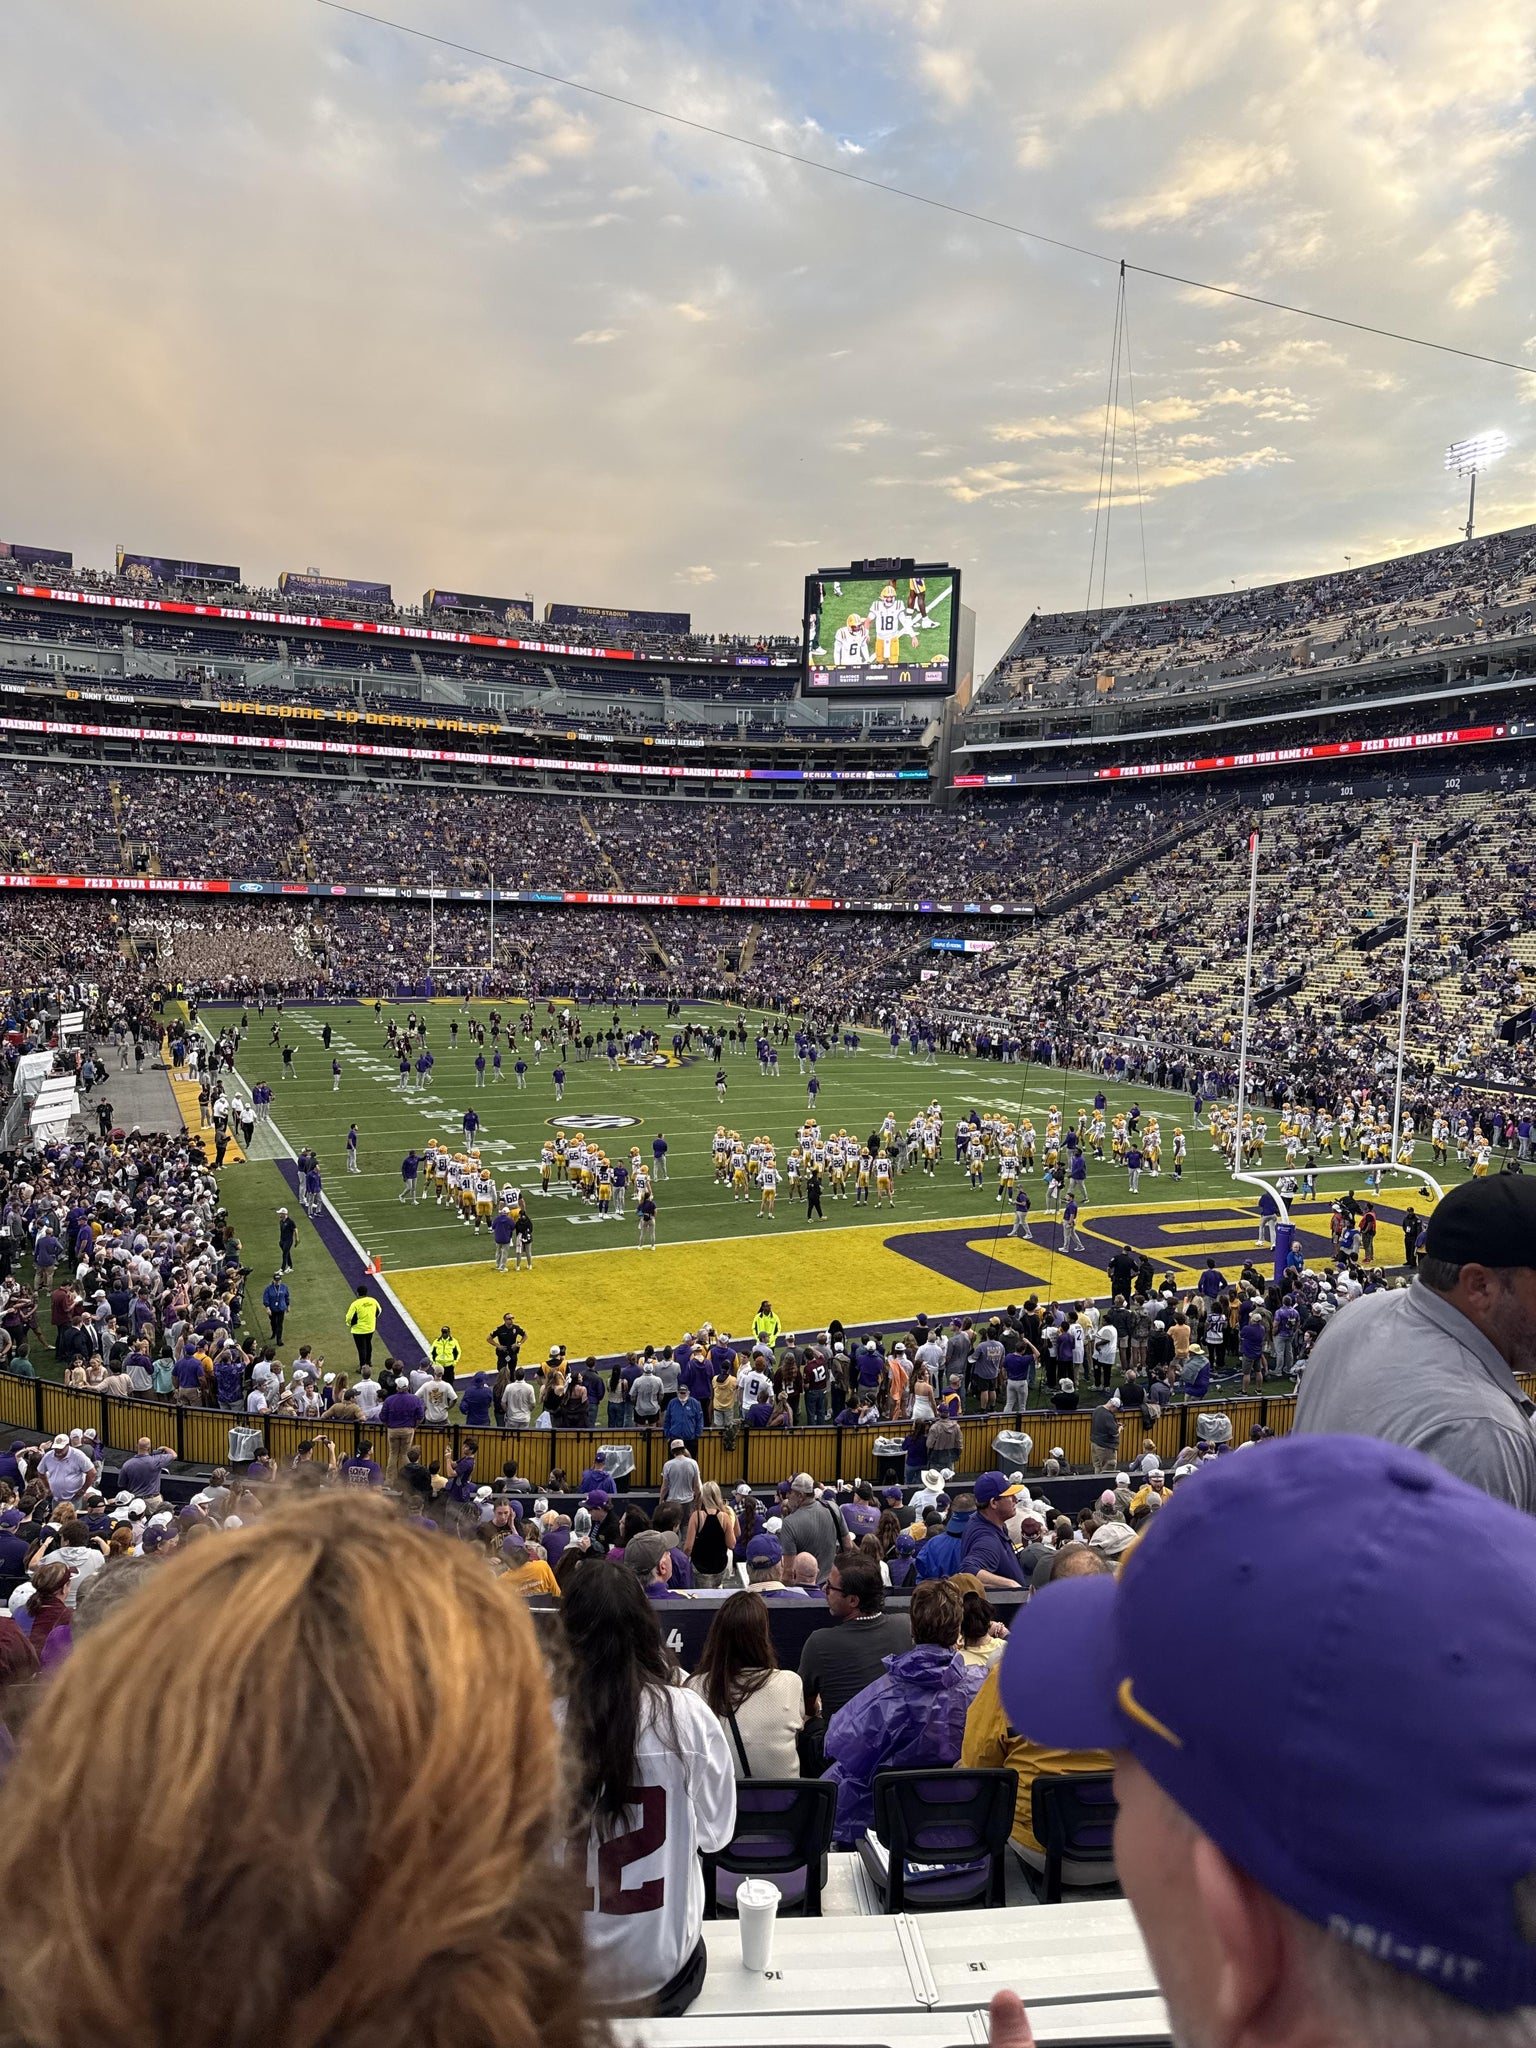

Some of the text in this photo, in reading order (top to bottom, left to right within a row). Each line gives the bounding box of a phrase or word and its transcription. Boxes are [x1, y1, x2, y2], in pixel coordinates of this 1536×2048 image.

[863, 558, 900, 572] LSU
[296, 576, 348, 587] TIGER STADIUM
[51, 591, 78, 602] FEED
[83, 594, 111, 606] YOUR
[115, 598, 144, 609] GAME
[220, 608, 246, 618] FEED
[250, 612, 276, 622] YOUR
[279, 615, 307, 626] GAME
[602, 610, 628, 618] STADIUM
[881, 616, 894, 630] 18
[376, 624, 400, 635] FEED
[404, 628, 428, 638] YOUR
[431, 631, 456, 642] GAME
[518, 641, 540, 650] FEED
[544, 644, 566, 654] YOUR
[568, 647, 592, 656] GAME
[850, 644, 858, 655] 6
[1, 685, 25, 693] CANNON
[81, 692, 101, 700] TOMMY
[220, 701, 500, 734] WELCOME TO DEATH VALLEY
[0, 719, 82, 732] RAISING CANE'S
[1511, 726, 1518, 734] 0
[100, 727, 178, 740] RAISING CANE'S
[195, 734, 270, 746] RAISING CANE'S
[655, 738, 676, 746] CHARLES
[1361, 740, 1384, 750] FEED
[1388, 737, 1412, 748] YOUR
[1416, 734, 1442, 745] GAME
[286, 740, 356, 752] RAISING CANE'S
[372, 746, 440, 759] RAISING CANE'S
[1234, 754, 1253, 765] FEED
[1256, 752, 1276, 762] YOUR
[1278, 748, 1301, 760] GAME
[455, 752, 520, 765] RAISING CANE'S
[534, 758, 594, 770] RAISING CANE'S
[608, 764, 670, 775] RAISING CANE'S
[684, 768, 745, 778] RAISING CANE'S
[1120, 767, 1138, 776] FEED
[1142, 764, 1160, 774] YOUR
[1163, 763, 1185, 772] GAME
[1445, 779, 1460, 789] 102
[1341, 787, 1354, 796] 101
[1262, 793, 1274, 802] 100
[84, 879, 112, 888] FEED
[117, 880, 146, 890] YOUR
[150, 880, 180, 890] GAME
[401, 889, 411, 897] 40
[587, 894, 608, 902] FEED
[612, 895, 634, 903] YOUR
[637, 896, 660, 904] GAME
[720, 898, 742, 906] FEED
[744, 898, 766, 907] YOUR
[770, 899, 792, 908] GAME
[925, 1132, 932, 1140] 14
[569, 1152, 579, 1160] 65
[439, 1161, 447, 1171] 61
[1005, 1161, 1015, 1169] 92
[462, 1180, 470, 1188] 41
[765, 1174, 773, 1183] 19
[477, 1184, 488, 1194] 94
[506, 1193, 518, 1203] 68
[812, 1366, 826, 1382] 12
[750, 1380, 759, 1395] 9
[666, 1628, 683, 1652] 4
[970, 1962, 986, 1971] 15
[765, 1971, 781, 1980] 16
